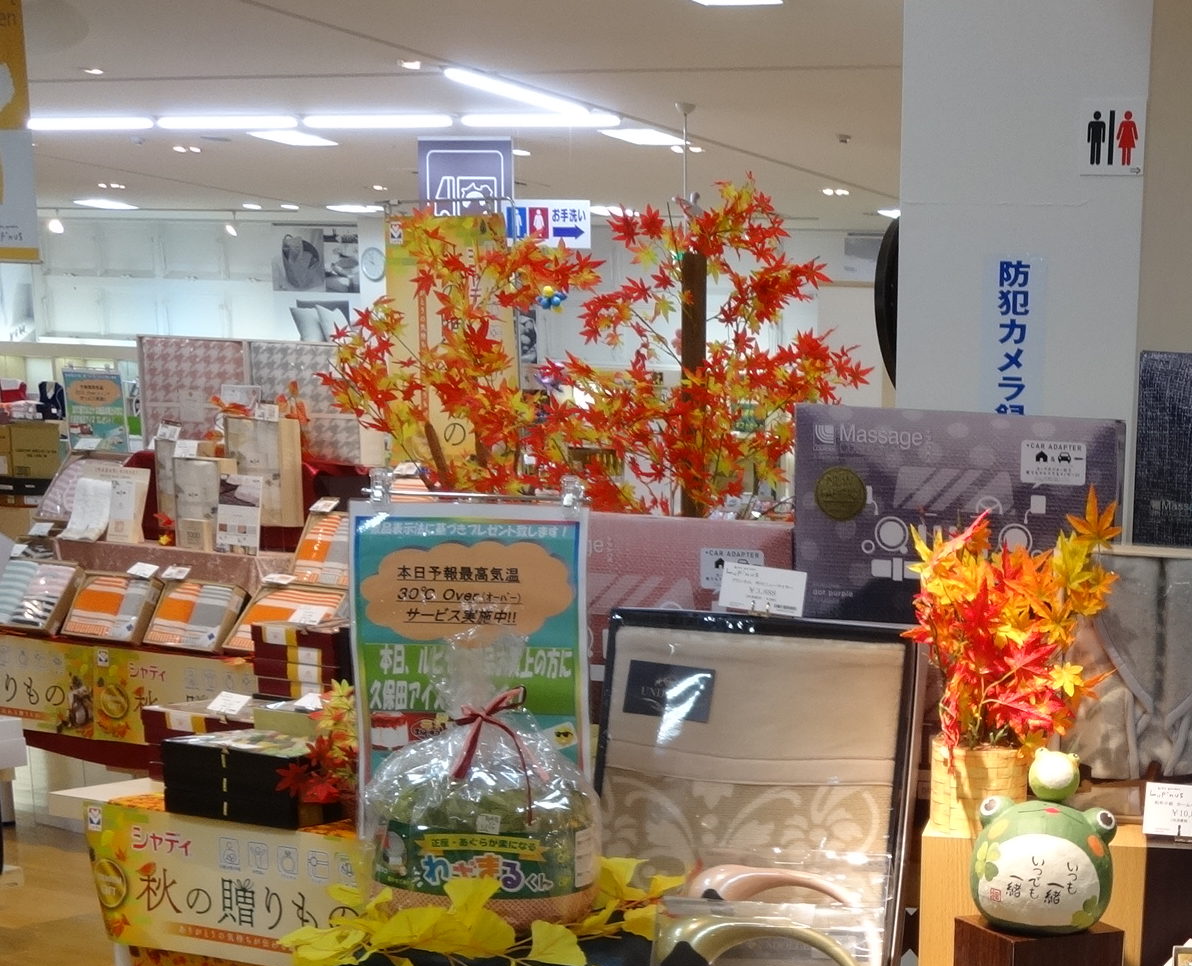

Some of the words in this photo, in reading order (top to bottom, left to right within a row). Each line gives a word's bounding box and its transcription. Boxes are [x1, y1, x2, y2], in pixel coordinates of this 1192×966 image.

[551, 208, 586, 223] お手洗い
[840, 424, 923, 450] Massage
[1048, 443, 1082, 451] ADAPTER
[726, 550, 760, 559] ADAPTER
[397, 565, 521, 582] 本日予報最高気温
[128, 661, 166, 683] シャディ
[131, 826, 192, 856] シャディ
[1067, 861, 1079, 895] いつも
